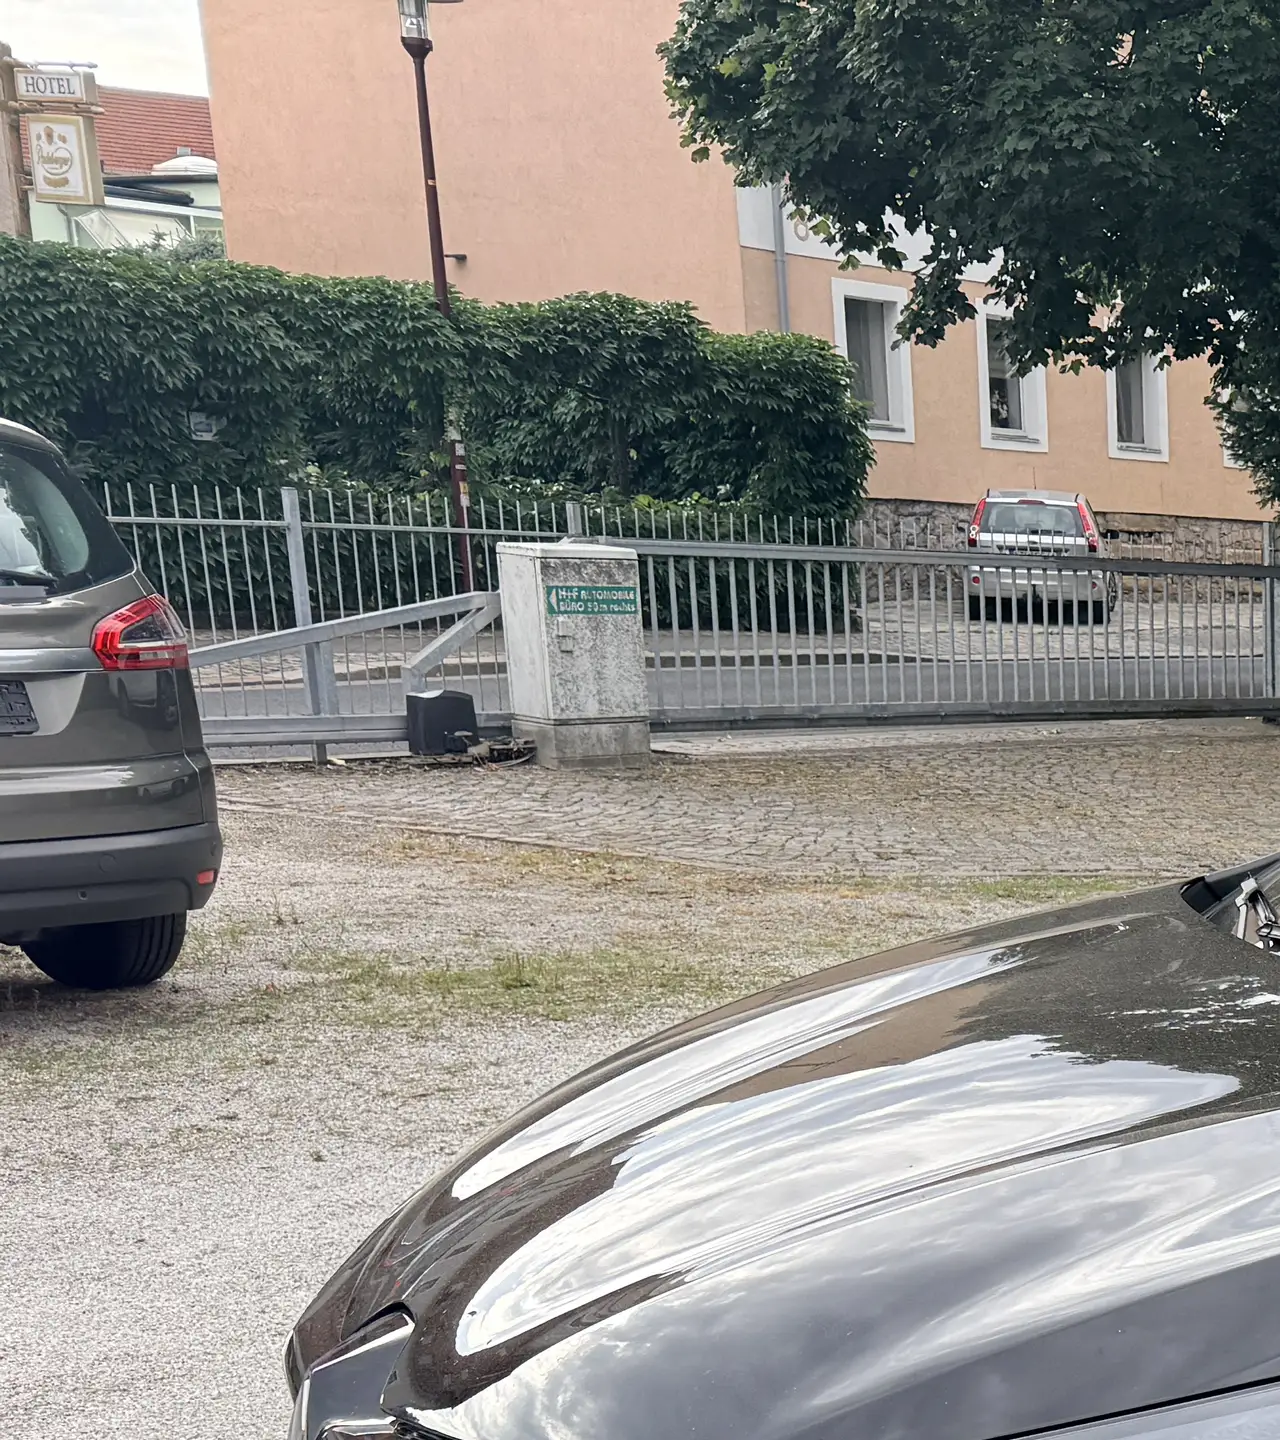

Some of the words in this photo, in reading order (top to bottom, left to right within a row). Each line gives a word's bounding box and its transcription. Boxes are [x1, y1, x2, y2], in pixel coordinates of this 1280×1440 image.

[23, 76, 75, 95] HOTEL
[581, 590, 635, 600] AUTOMOBILE
[559, 600, 585, 612] BÜRO
[609, 601, 636, 612] rechts
